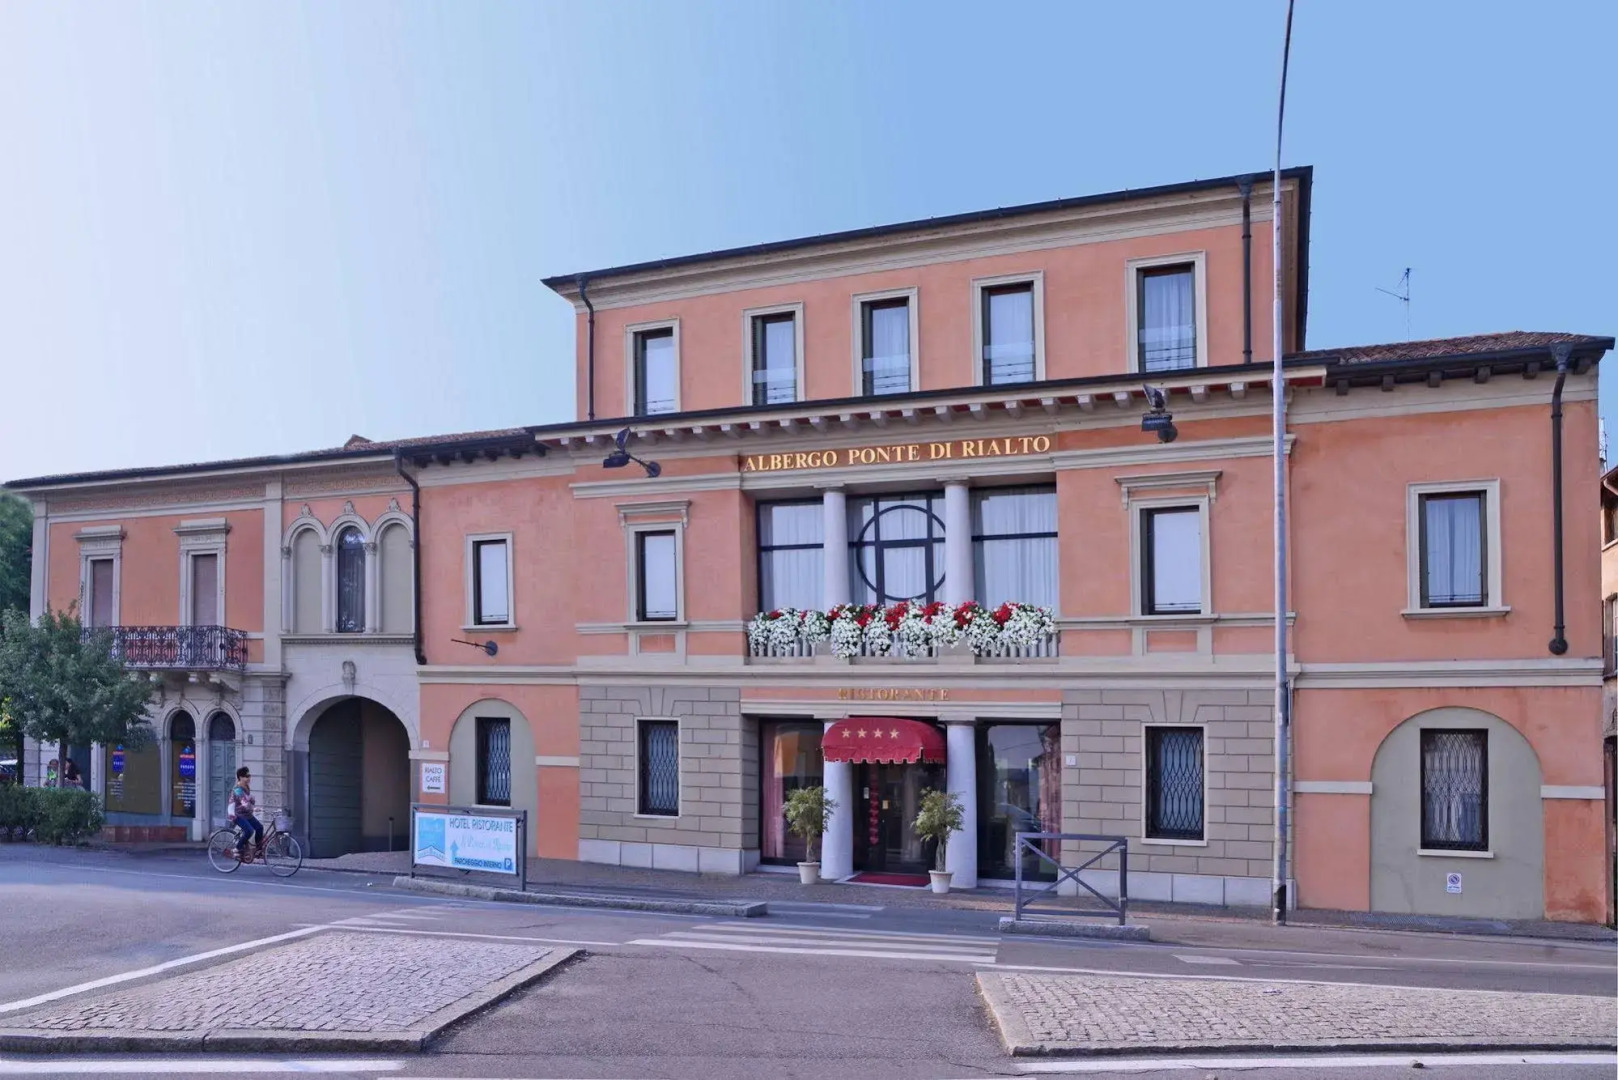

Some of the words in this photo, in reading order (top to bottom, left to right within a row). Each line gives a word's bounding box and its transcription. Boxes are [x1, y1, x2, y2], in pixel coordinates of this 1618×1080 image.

[743, 450, 838, 472] ALBERGO
[848, 444, 920, 465] PONTE
[930, 442, 952, 460] DI
[962, 436, 1050, 457] RIALTO
[838, 688, 950, 701] RISTORANTE
[449, 818, 470, 829] HOTEL
[472, 819, 513, 832] RISTORANTE
